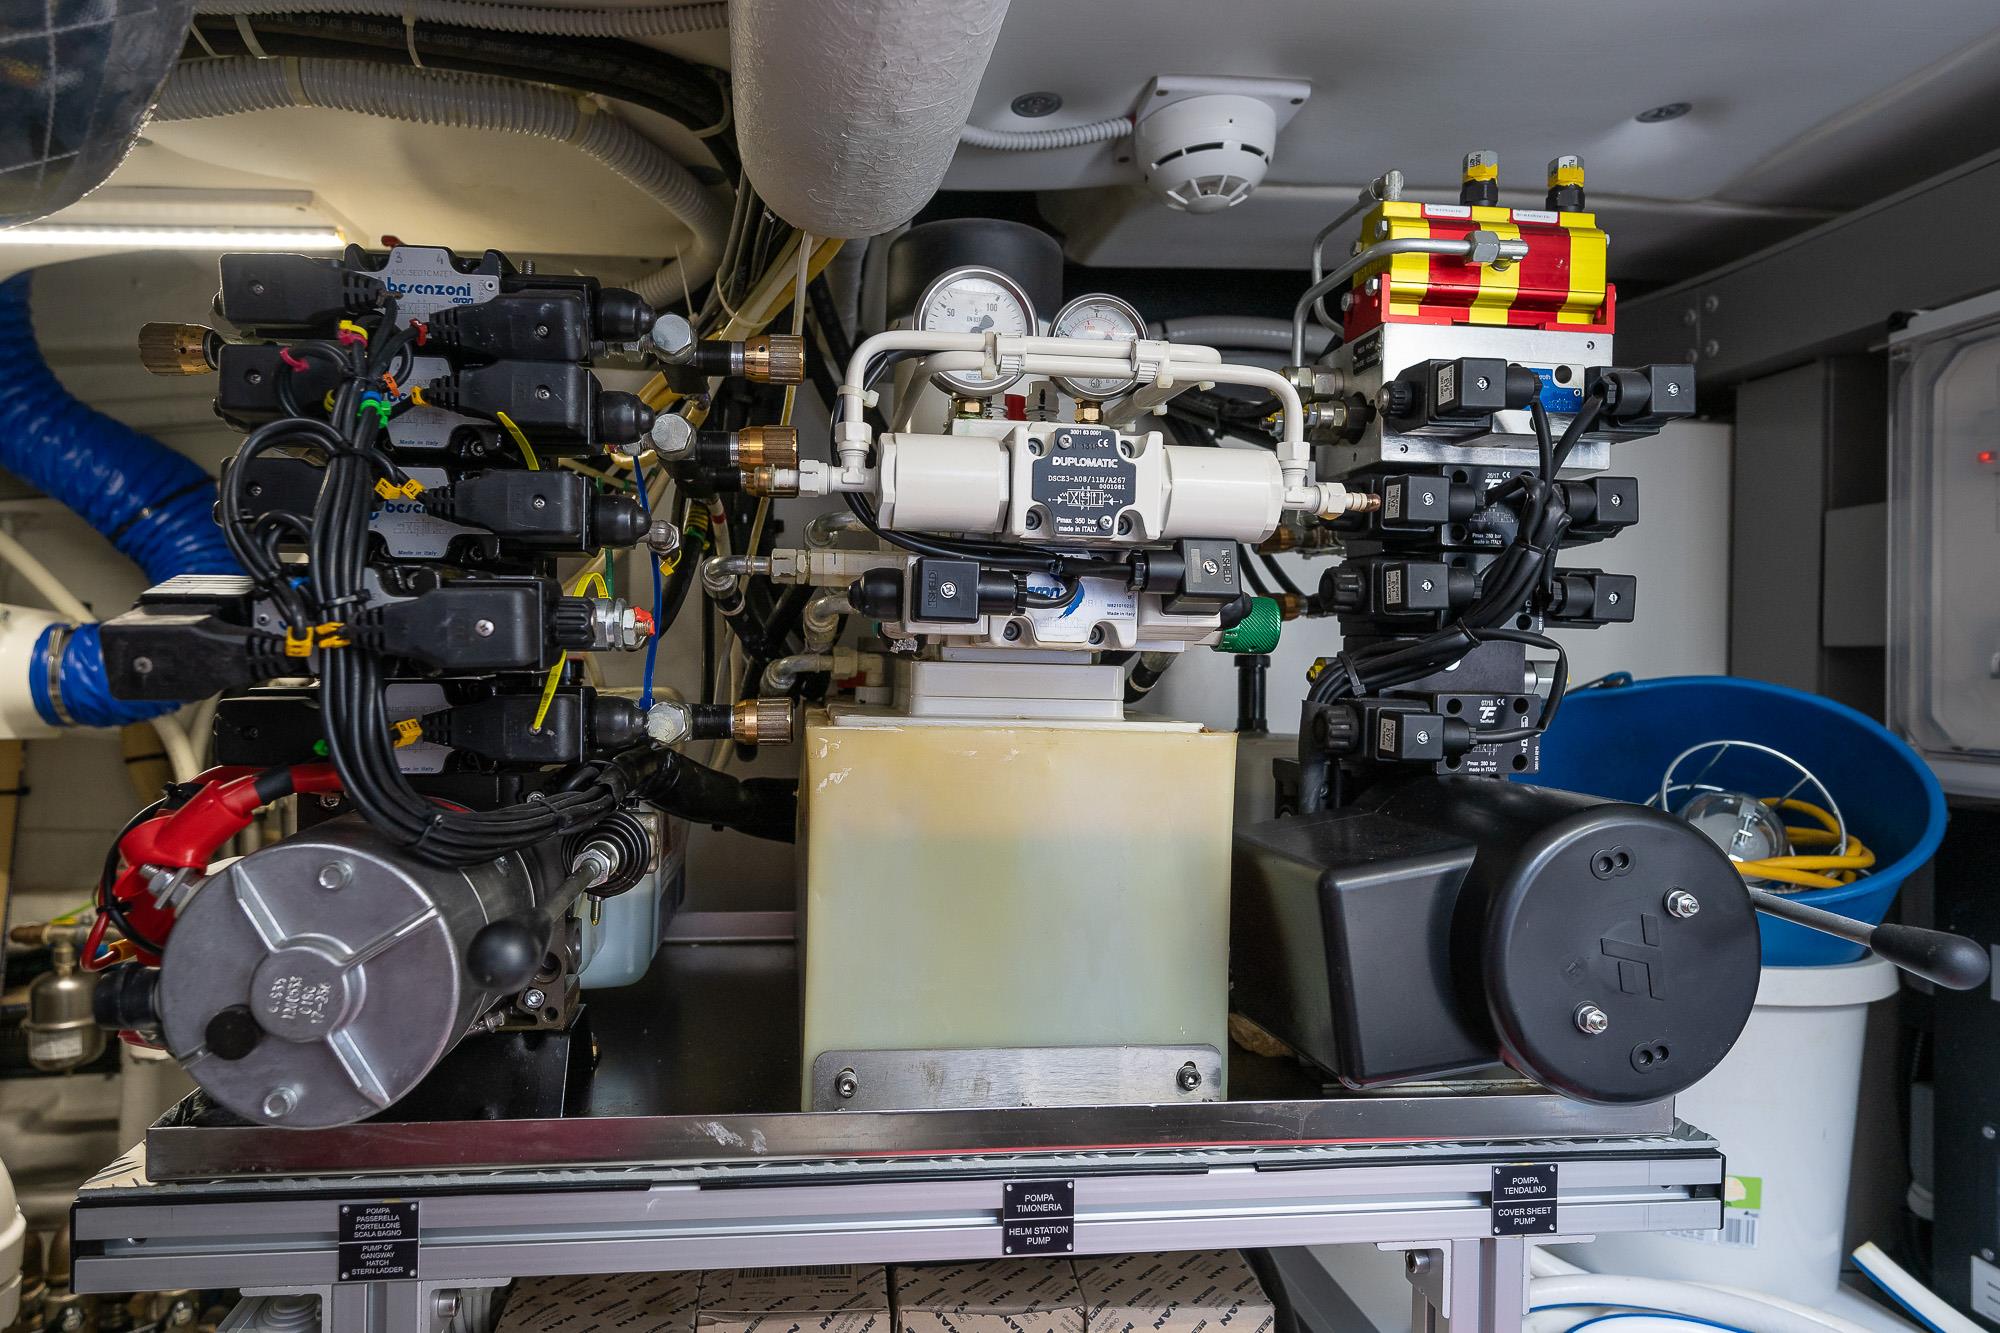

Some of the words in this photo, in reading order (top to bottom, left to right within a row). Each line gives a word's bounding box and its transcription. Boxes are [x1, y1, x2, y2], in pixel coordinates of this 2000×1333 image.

[386, 276, 472, 296] besenzoni
[986, 303, 998, 312] 100
[946, 308, 955, 317] 50
[1052, 456, 1118, 468] DUPLOMATIC
[1512, 1176, 1539, 1184] POMPA
[1504, 1186, 1546, 1194] TENDALINO
[1025, 1194, 1054, 1202] POMPA
[1016, 1204, 1062, 1213] TIMONERIA
[1498, 1208, 1525, 1216] COVER
[1526, 1206, 1552, 1215] SHEET
[355, 1222, 400, 1230] PORTELLONE
[1009, 1227, 1032, 1236] HELM
[1034, 1226, 1069, 1234] STATION
[1026, 1236, 1051, 1245] PUMP
[1153, 1300, 1180, 1330] MAN
[1220, 1298, 1246, 1326] MAN
